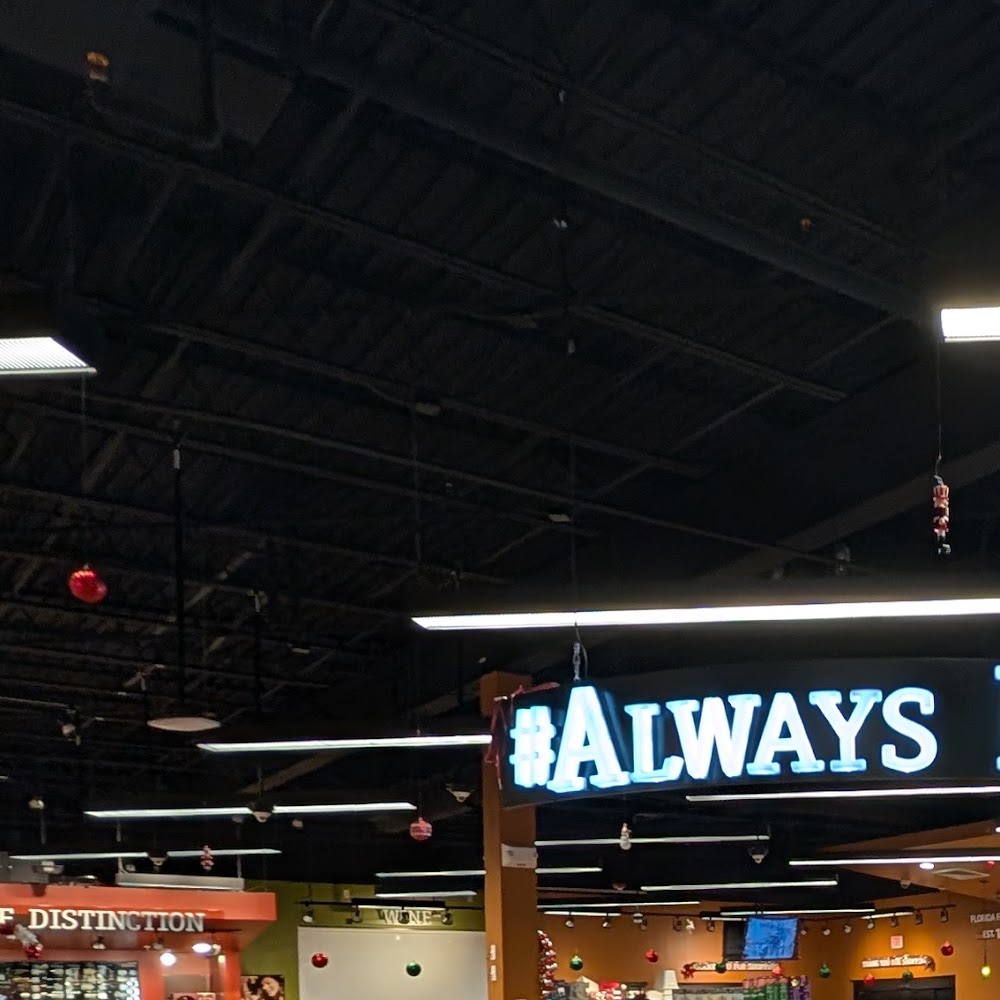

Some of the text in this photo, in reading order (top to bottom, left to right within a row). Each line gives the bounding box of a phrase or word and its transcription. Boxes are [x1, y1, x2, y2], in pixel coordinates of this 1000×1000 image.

[510, 685, 939, 794] #ALWAYS
[28, 908, 206, 932] DISTINCTION
[970, 912, 996, 924] FLORIDA
